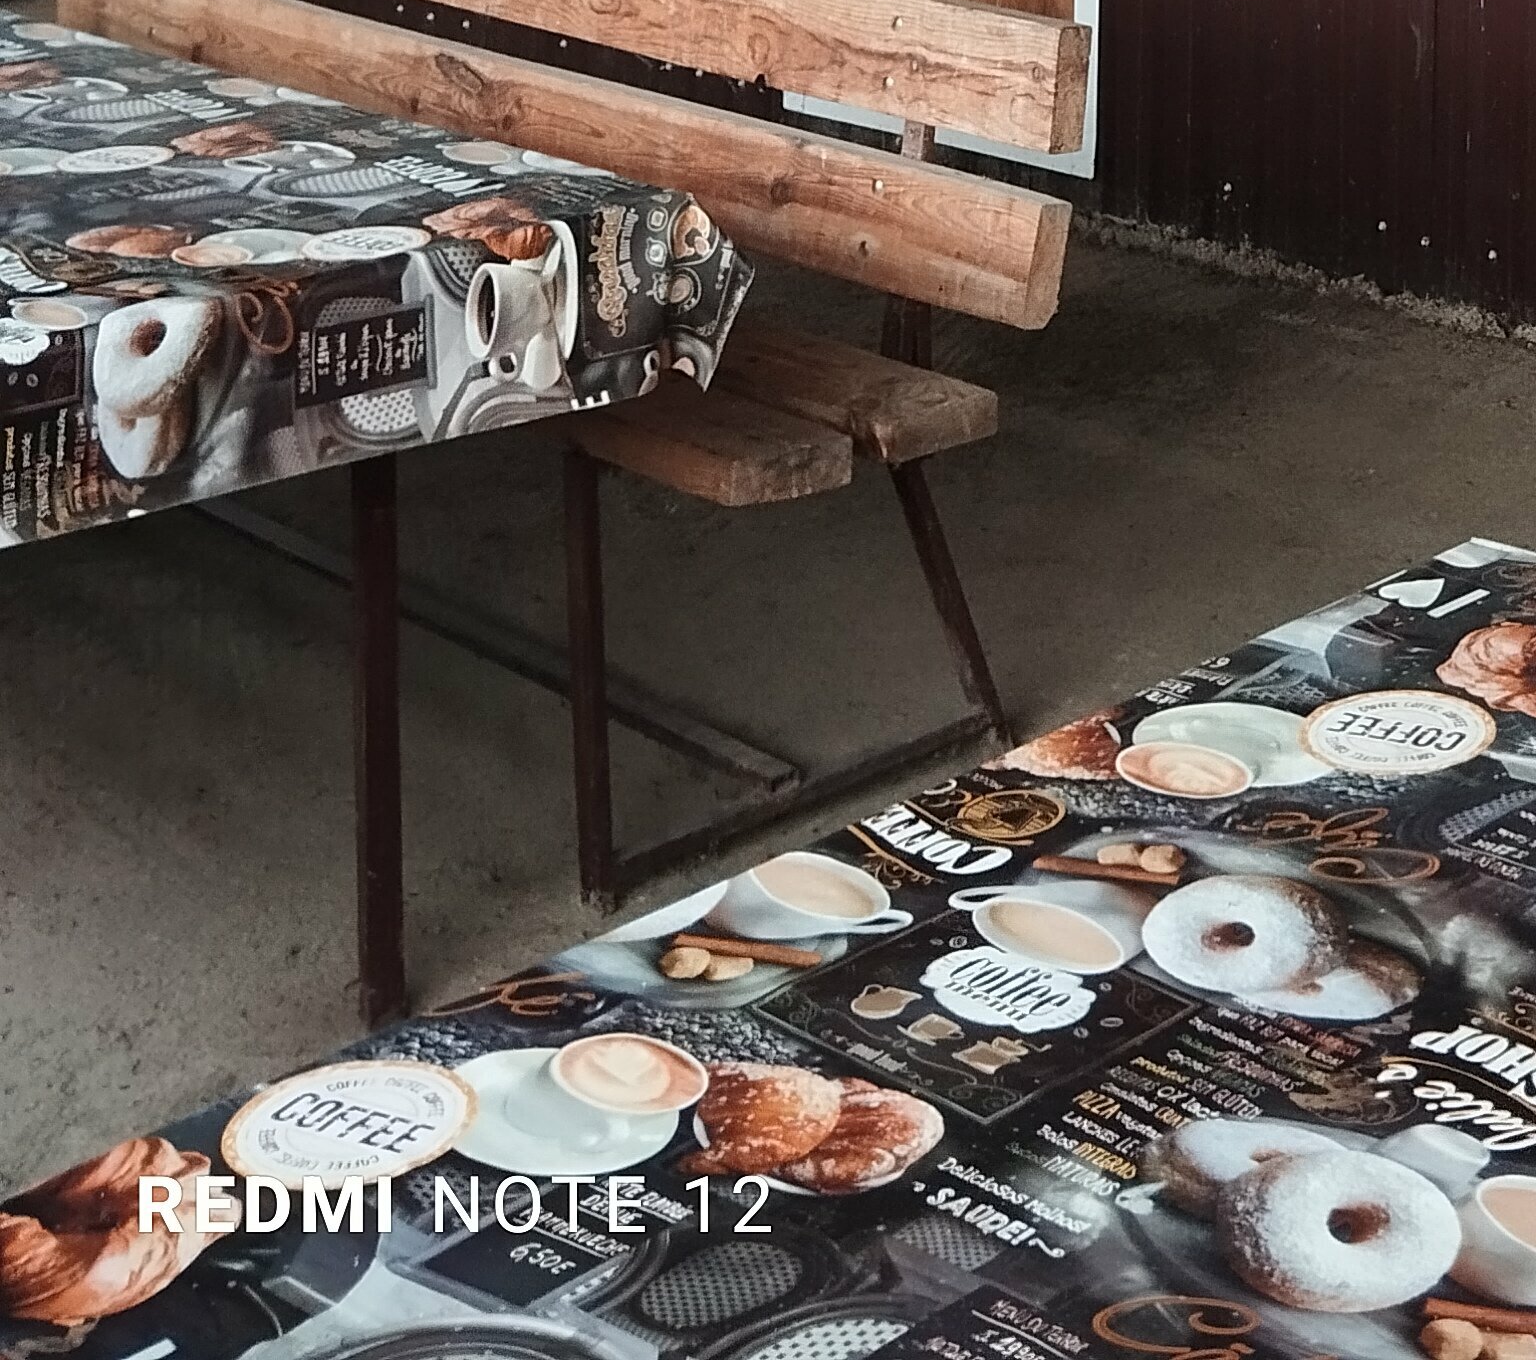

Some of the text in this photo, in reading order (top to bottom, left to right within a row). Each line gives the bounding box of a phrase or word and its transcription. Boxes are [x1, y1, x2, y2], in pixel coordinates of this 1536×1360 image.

[1326, 712, 1467, 751] COFFEE
[950, 957, 1071, 1017] coffee
[271, 1092, 436, 1154] COFFEE
[1072, 1089, 1119, 1121] PIZZA
